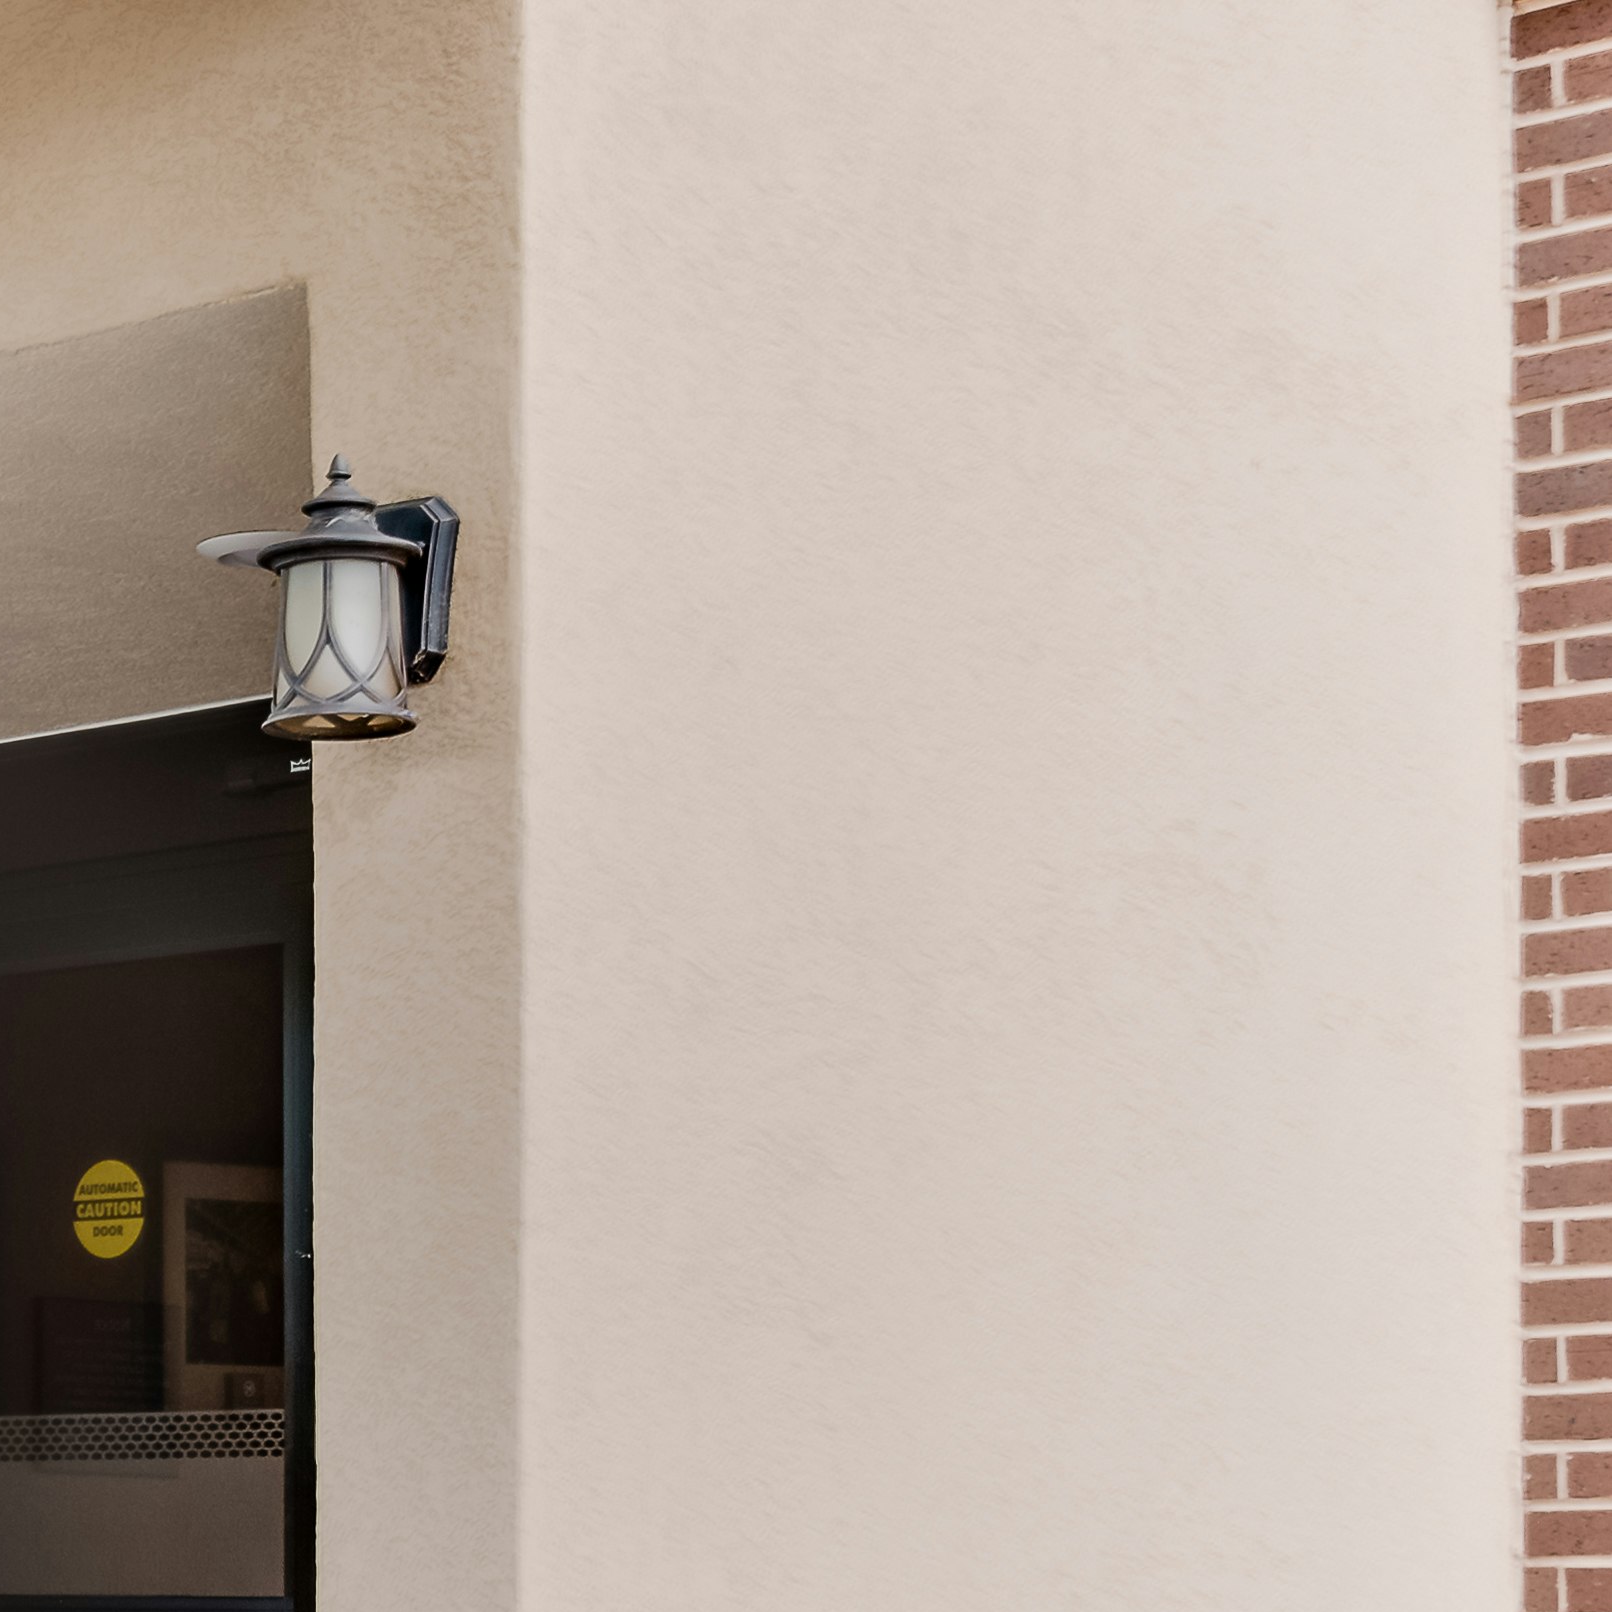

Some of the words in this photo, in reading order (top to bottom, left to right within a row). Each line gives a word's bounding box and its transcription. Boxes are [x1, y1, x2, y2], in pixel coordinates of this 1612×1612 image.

[79, 1181, 138, 1195] AUTOMATIC
[76, 1201, 141, 1218] CAUTION
[93, 1225, 123, 1237] DOOR
